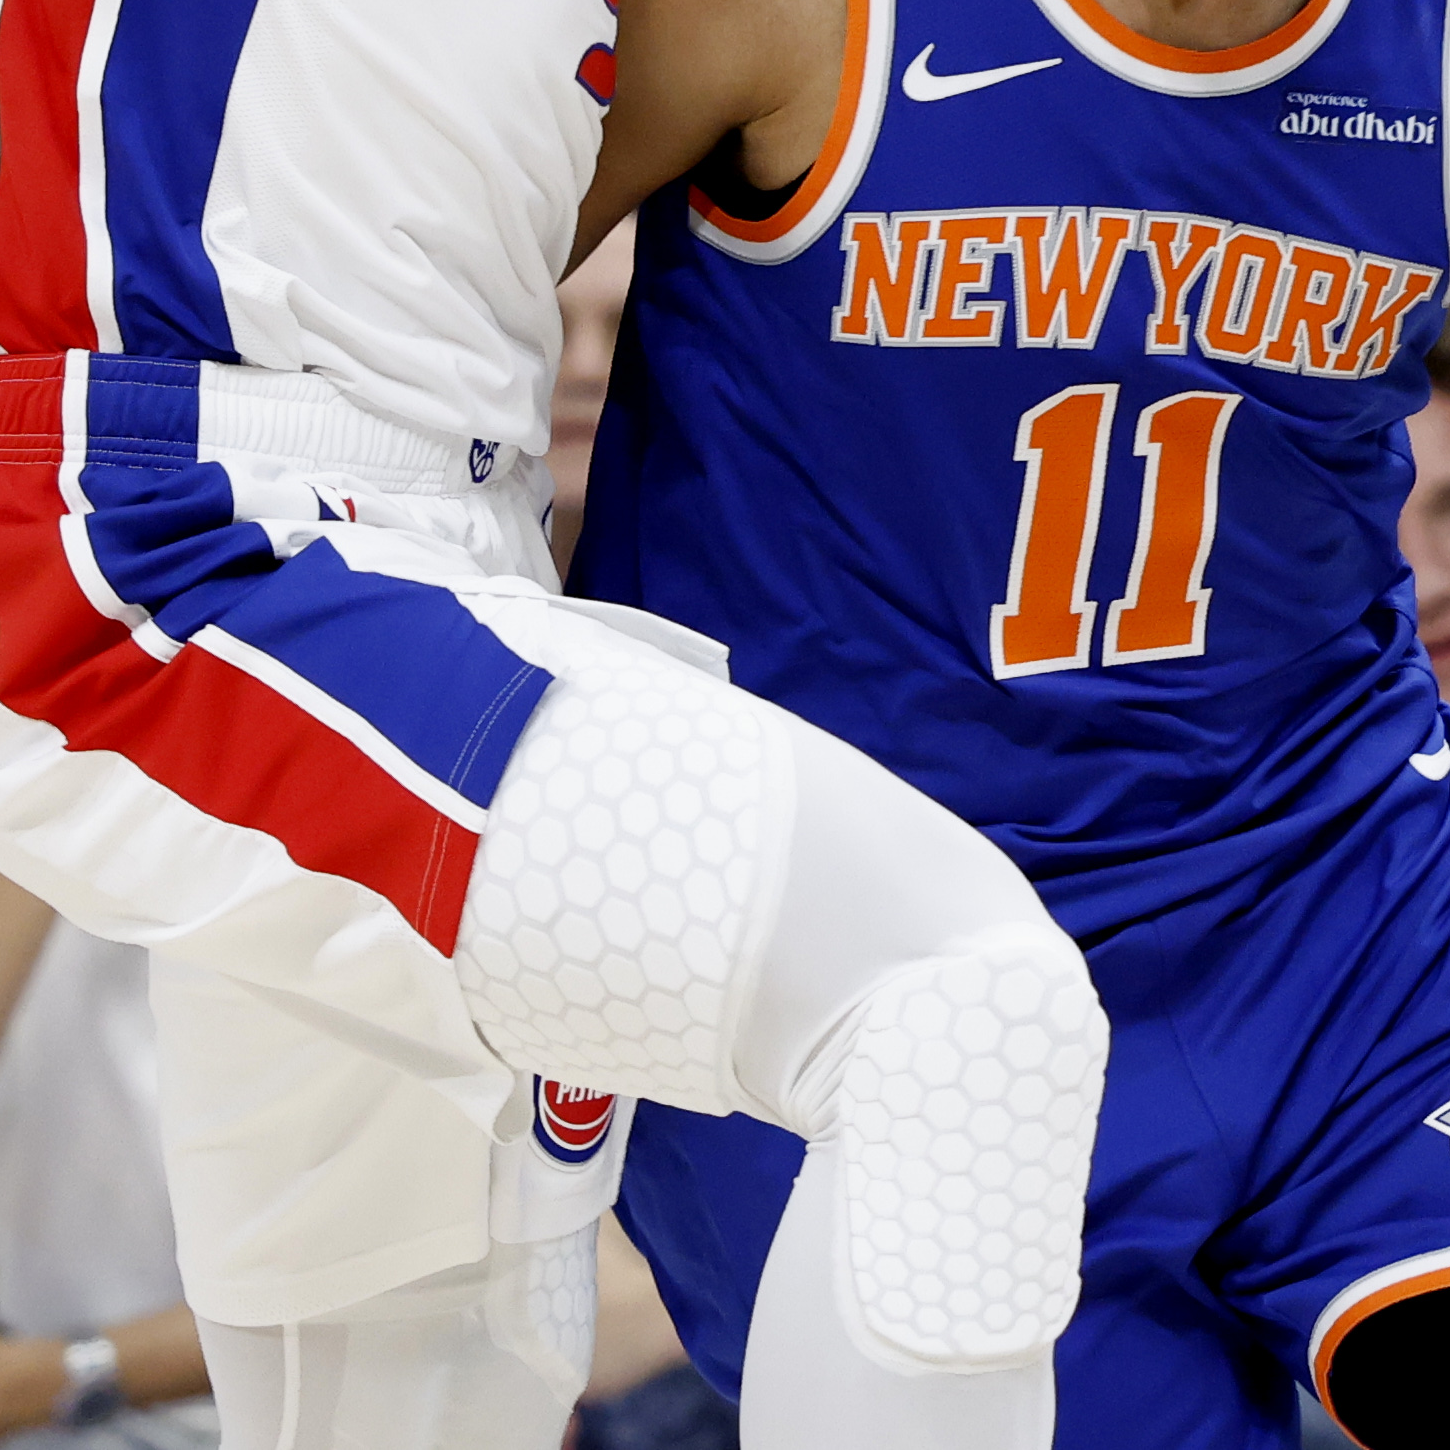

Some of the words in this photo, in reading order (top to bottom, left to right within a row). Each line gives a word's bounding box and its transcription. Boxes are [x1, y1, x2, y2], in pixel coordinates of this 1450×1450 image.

[1279, 107, 1341, 138] abu
[1342, 110, 1438, 145] dhabi
[1286, 91, 1369, 108] experience
[830, 205, 1142, 349] NEW
[1142, 209, 1443, 380] YORK
[990, 382, 1244, 681] 11
